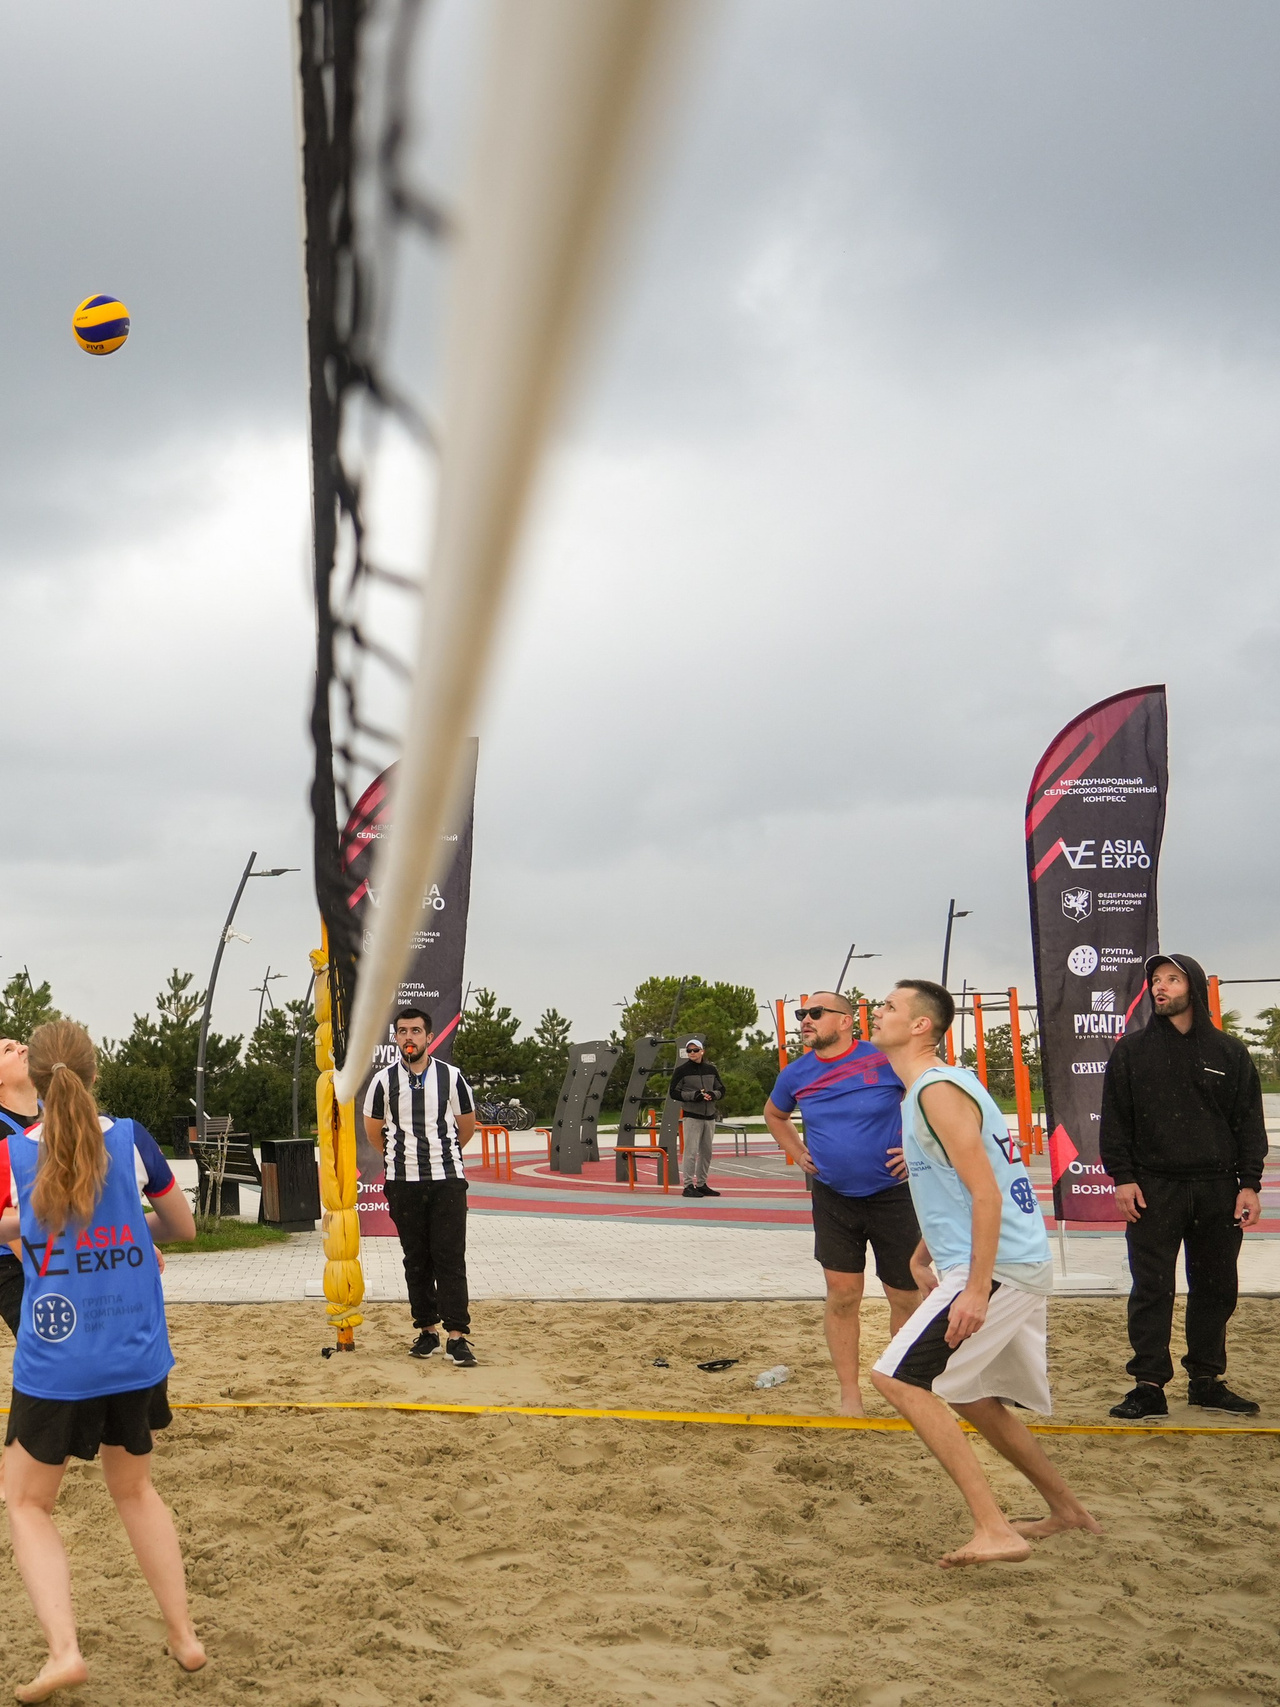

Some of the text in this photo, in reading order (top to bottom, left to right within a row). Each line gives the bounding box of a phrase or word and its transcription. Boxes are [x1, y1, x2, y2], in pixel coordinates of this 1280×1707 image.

[1060, 777, 1143, 787] МЕЖДУНАРОДНЫЙ
[1044, 786, 1158, 796] СЕЛЬСКОХОЗЯЙСТВЕННЫЙ
[1082, 795, 1127, 803] КОНГРЕСС
[1101, 839, 1146, 854] ASIA
[1101, 854, 1151, 869] EXPO
[1100, 956, 1143, 964] КОМПАНИЙ
[397, 990, 440, 998] КОМПАНИЙ
[75, 1224, 135, 1251] ASIA
[76, 1246, 144, 1274] EXPO
[82, 1294, 123, 1307] ГРУППА
[84, 1321, 105, 1333] ВИК
